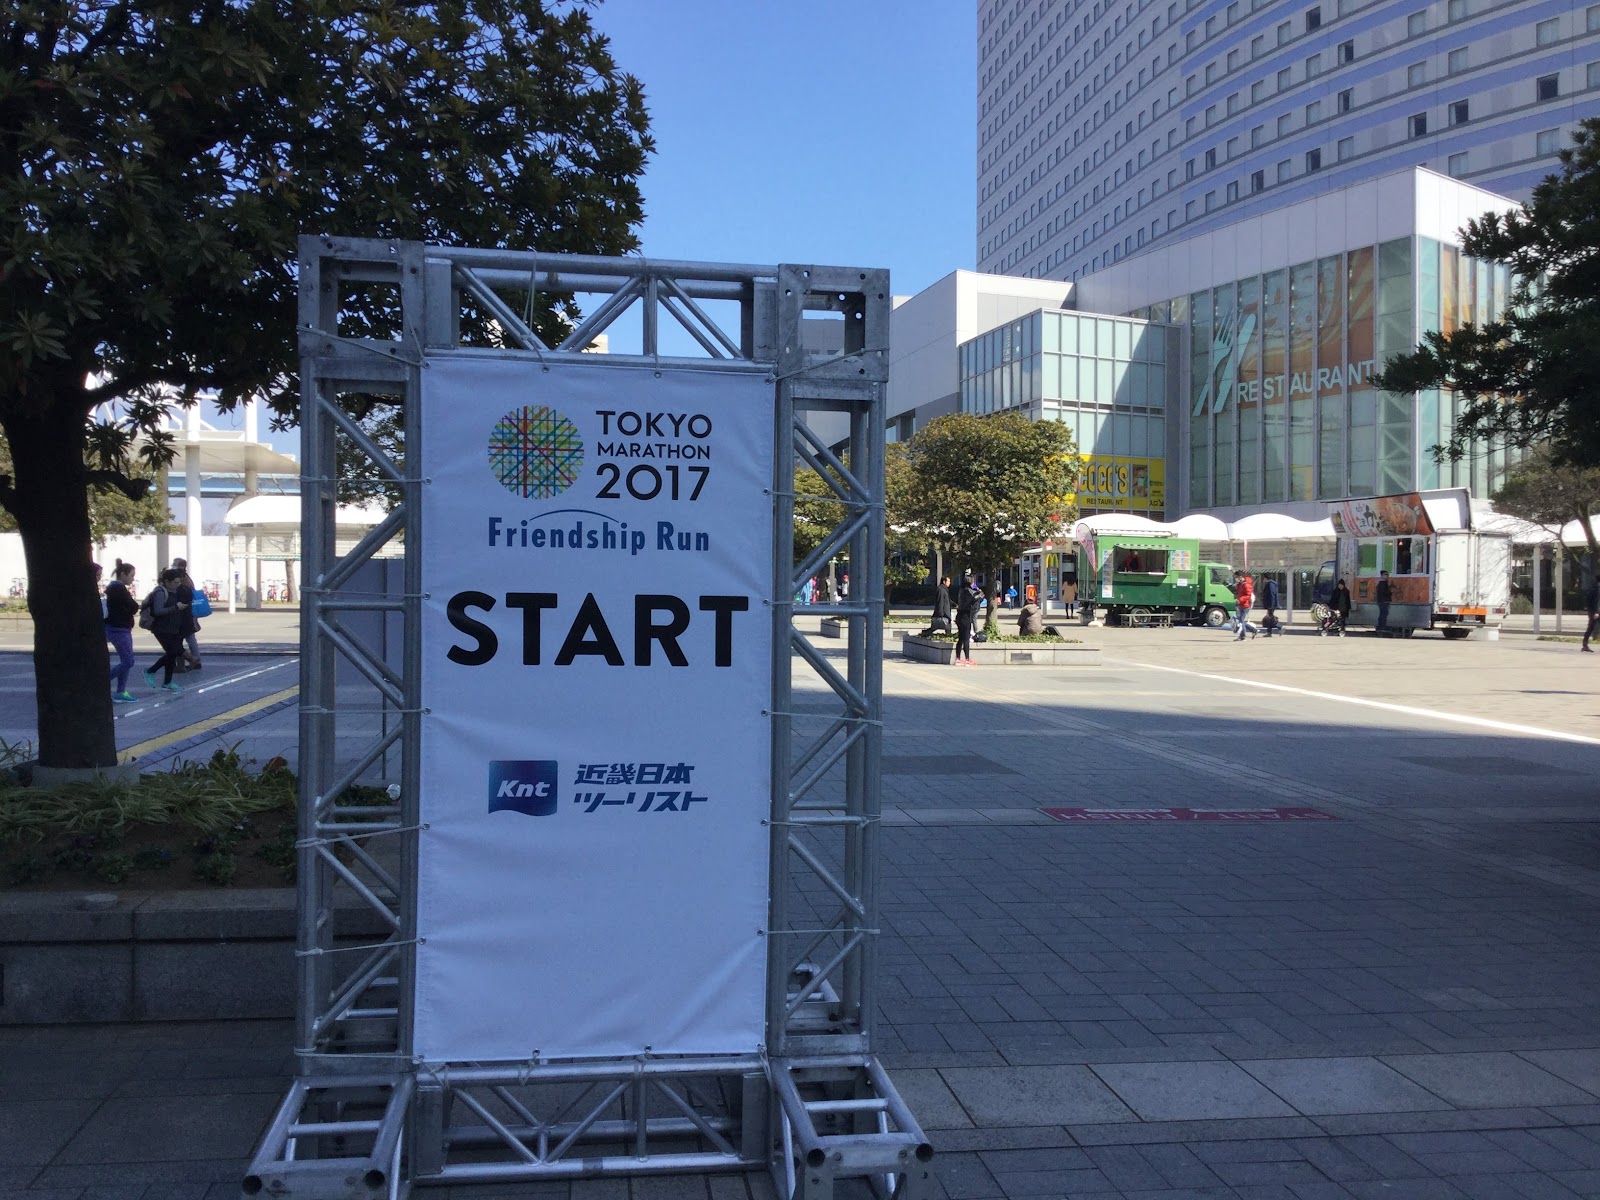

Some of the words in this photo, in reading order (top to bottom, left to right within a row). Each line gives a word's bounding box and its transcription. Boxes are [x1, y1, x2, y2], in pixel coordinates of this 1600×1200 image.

[1237, 359, 1374, 404] RESTAURANT
[596, 410, 712, 439] TOKYO
[598, 442, 710, 460] MARATHON
[595, 463, 710, 501] 2017
[1087, 498, 1123, 506] RESTAURNT
[489, 517, 645, 555] Friendship
[657, 522, 709, 551] Run
[446, 590, 748, 667] START
[574, 763, 695, 785] 近畿日本
[497, 780, 550, 799] Knt
[573, 791, 708, 812] ツーリスト
